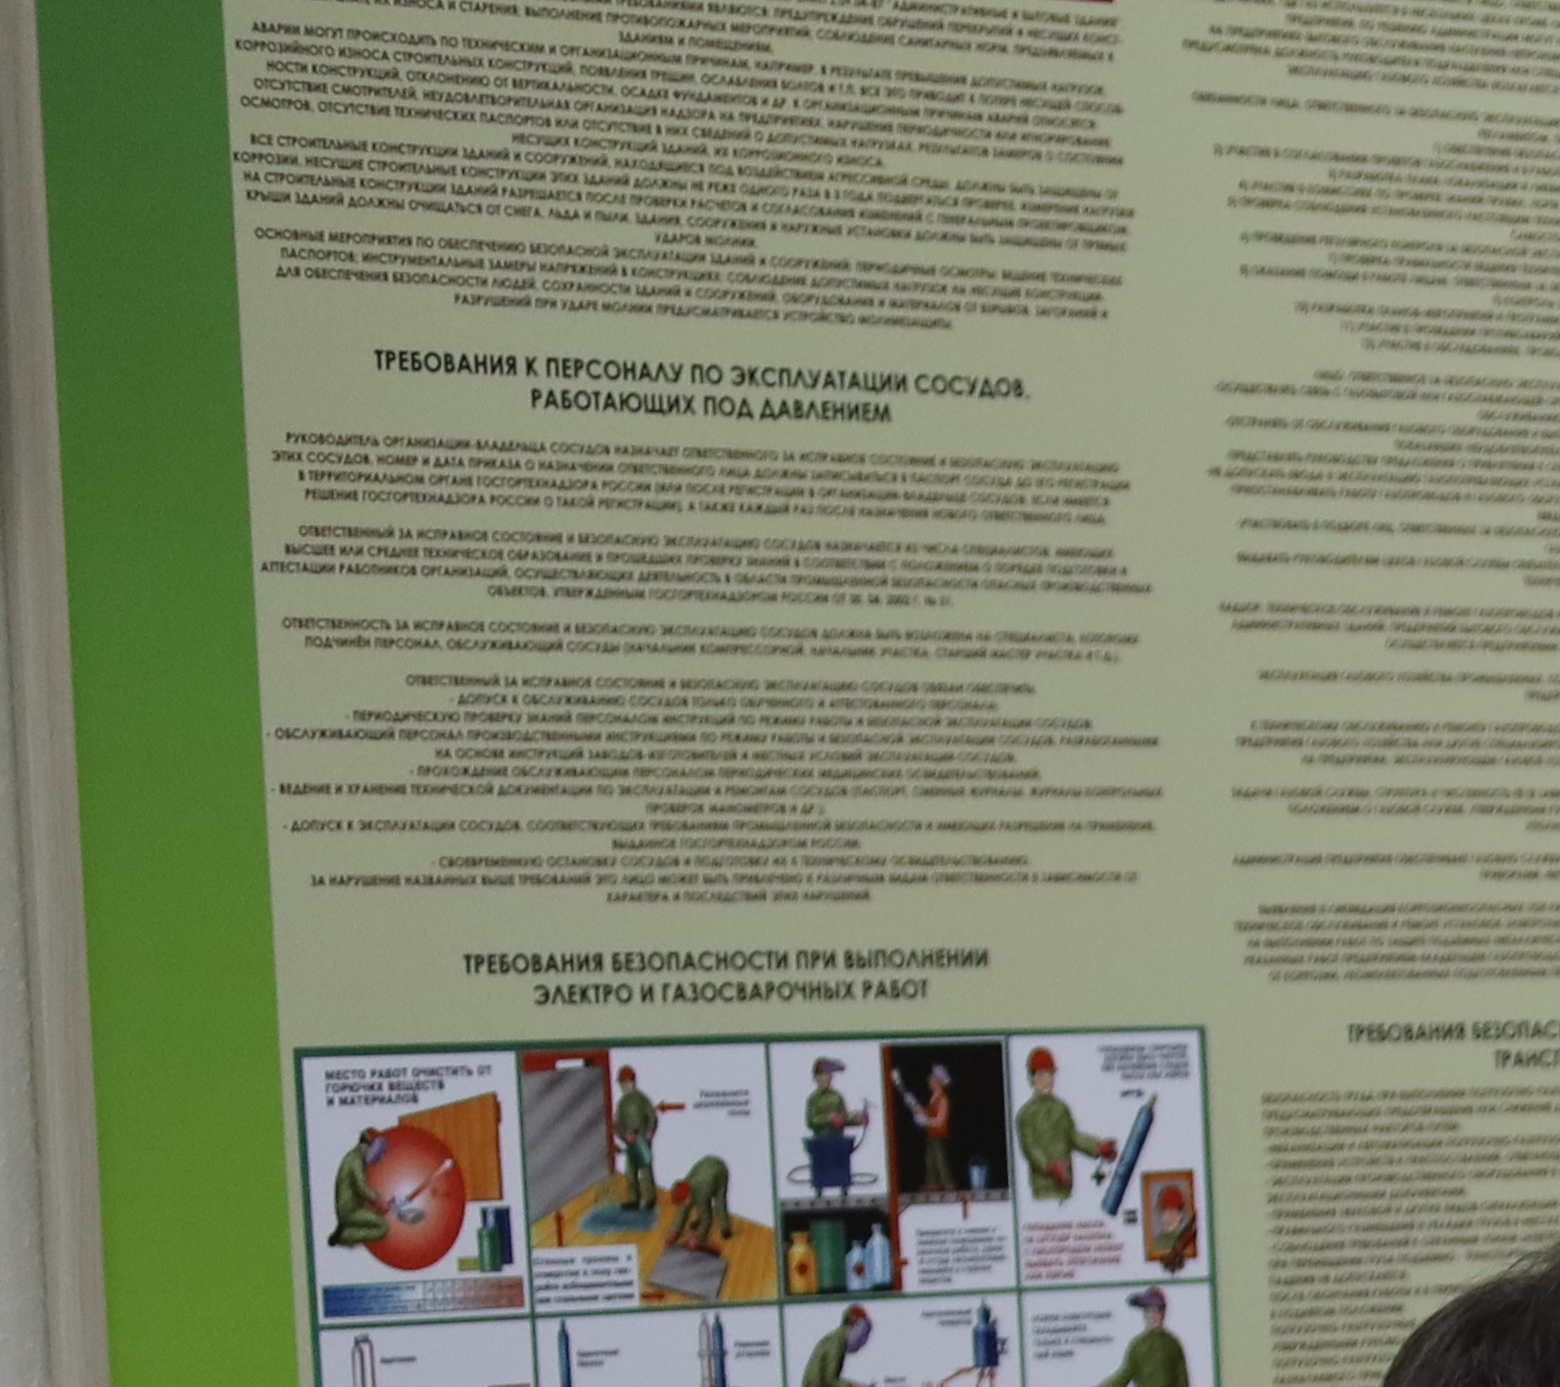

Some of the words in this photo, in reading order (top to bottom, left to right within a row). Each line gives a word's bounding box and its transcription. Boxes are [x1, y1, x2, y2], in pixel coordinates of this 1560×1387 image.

[375, 350, 517, 377] ТРЕБОВАНИЯ
[524, 356, 538, 378] К
[545, 357, 683, 384] ПЕРСОНАЛУ
[690, 363, 723, 386] ПО
[731, 364, 908, 393] ЭКСПЛУАТАЦИИ
[530, 389, 695, 416] РАБОТАЮЩИХ
[703, 395, 754, 418] ПОД
[759, 397, 892, 423] ДАВЛЕНИЕМ
[463, 952, 604, 974] ТРЕБОВАНИЯ
[611, 950, 789, 973] БЕЗОПАСНОСТИ
[795, 949, 837, 971] ПРИ
[843, 948, 990, 970] ВЫПОЛНЕНИИ
[533, 982, 634, 1005] ЭЛЕКТРО
[640, 982, 654, 1004] И
[661, 980, 855, 1004] ГАЗОСВАРОЧНЫХ
[862, 979, 928, 1001] РАБОТ
